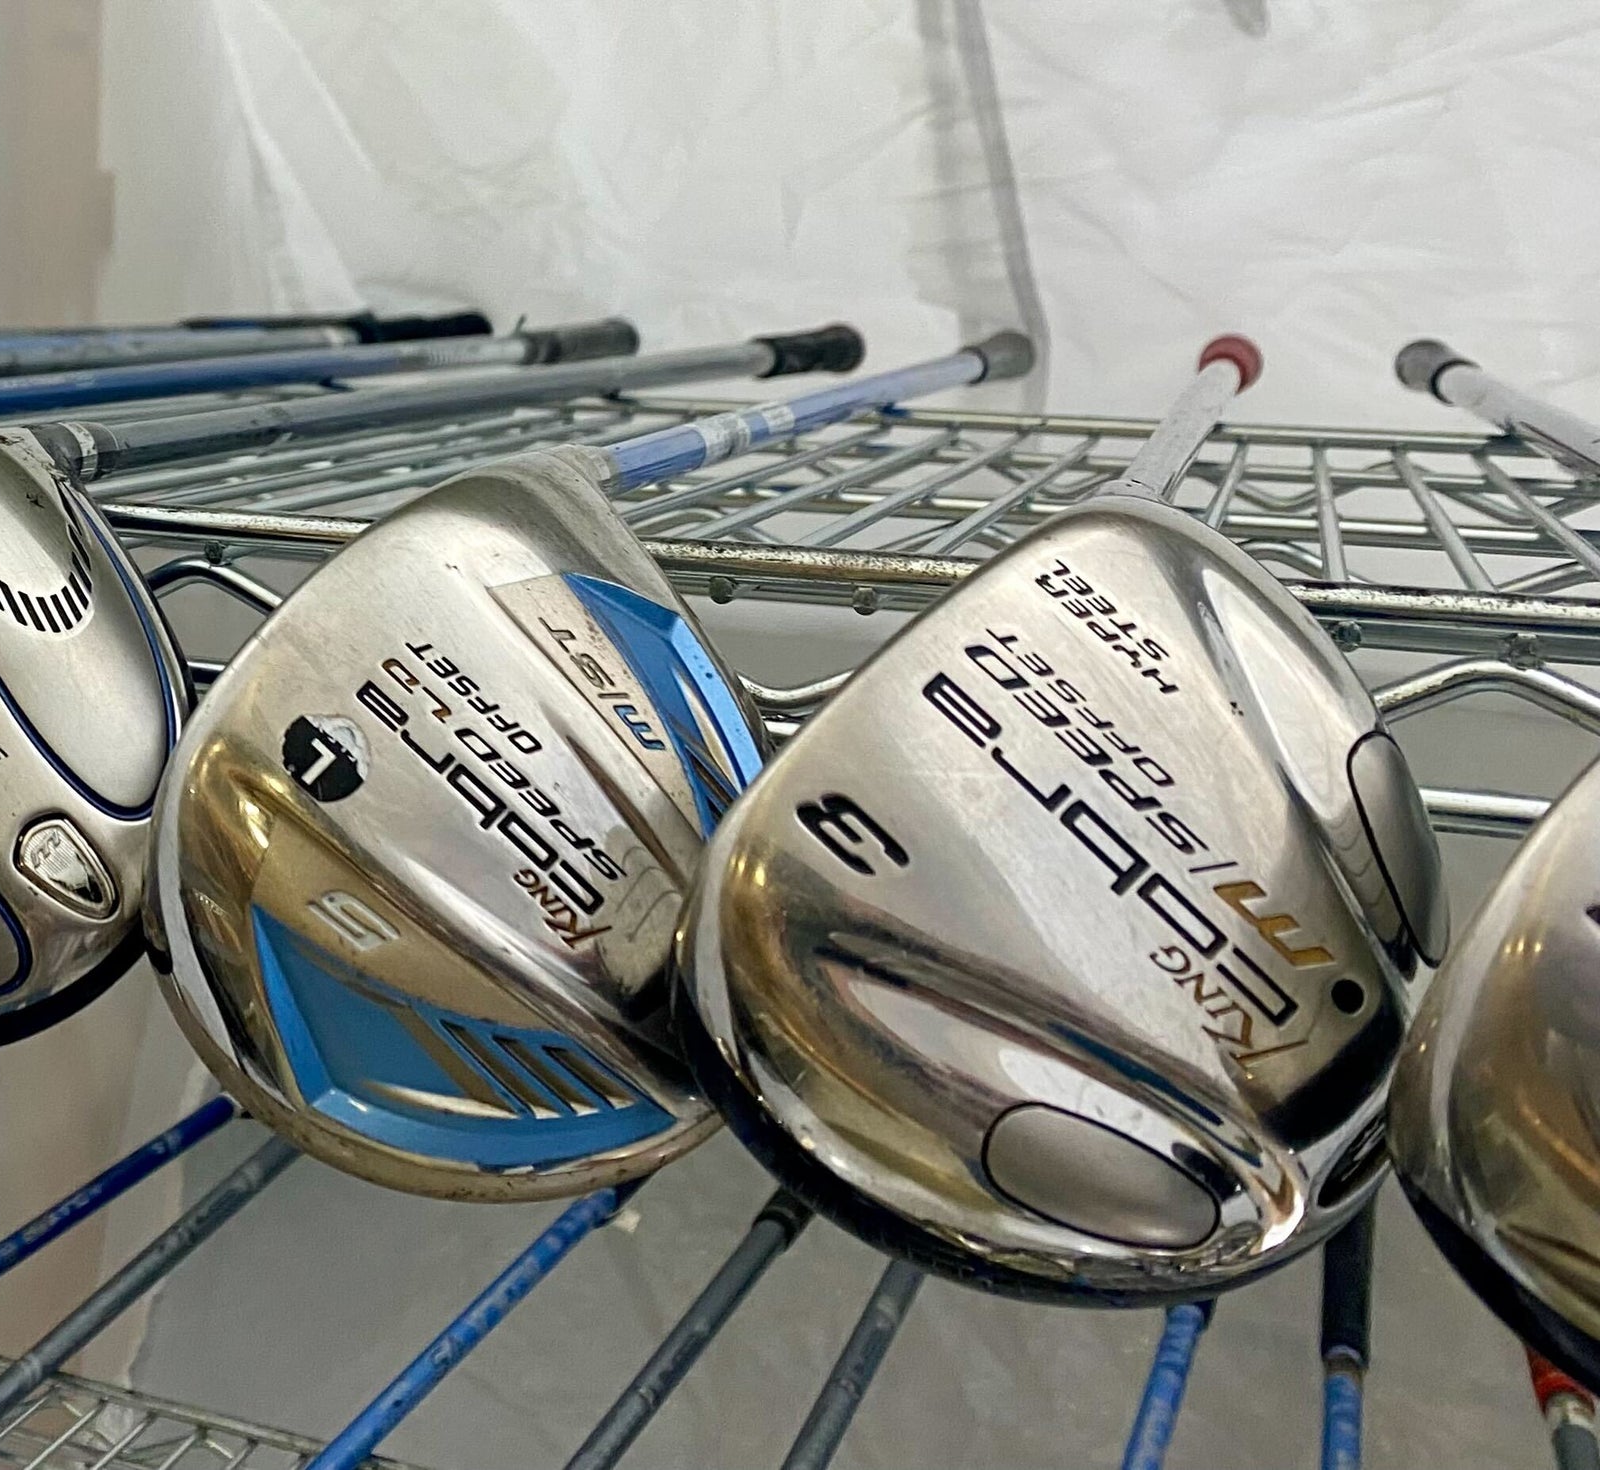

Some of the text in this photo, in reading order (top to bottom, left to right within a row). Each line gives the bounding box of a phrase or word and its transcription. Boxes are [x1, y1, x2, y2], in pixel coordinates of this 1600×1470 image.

[1032, 572, 1182, 696] HYPER
[1053, 558, 1172, 662] STEEL
[406, 640, 544, 756] OFFSET
[985, 626, 1178, 789] OFFSET
[299, 735, 339, 786] L
[355, 678, 607, 918] cobra
[455, 726, 628, 882] SPEED
[795, 792, 912, 878] 3
[921, 671, 1302, 1027] cobra
[307, 890, 401, 951] 5
[512, 867, 613, 950] KING
[1148, 943, 1309, 1078] KING
